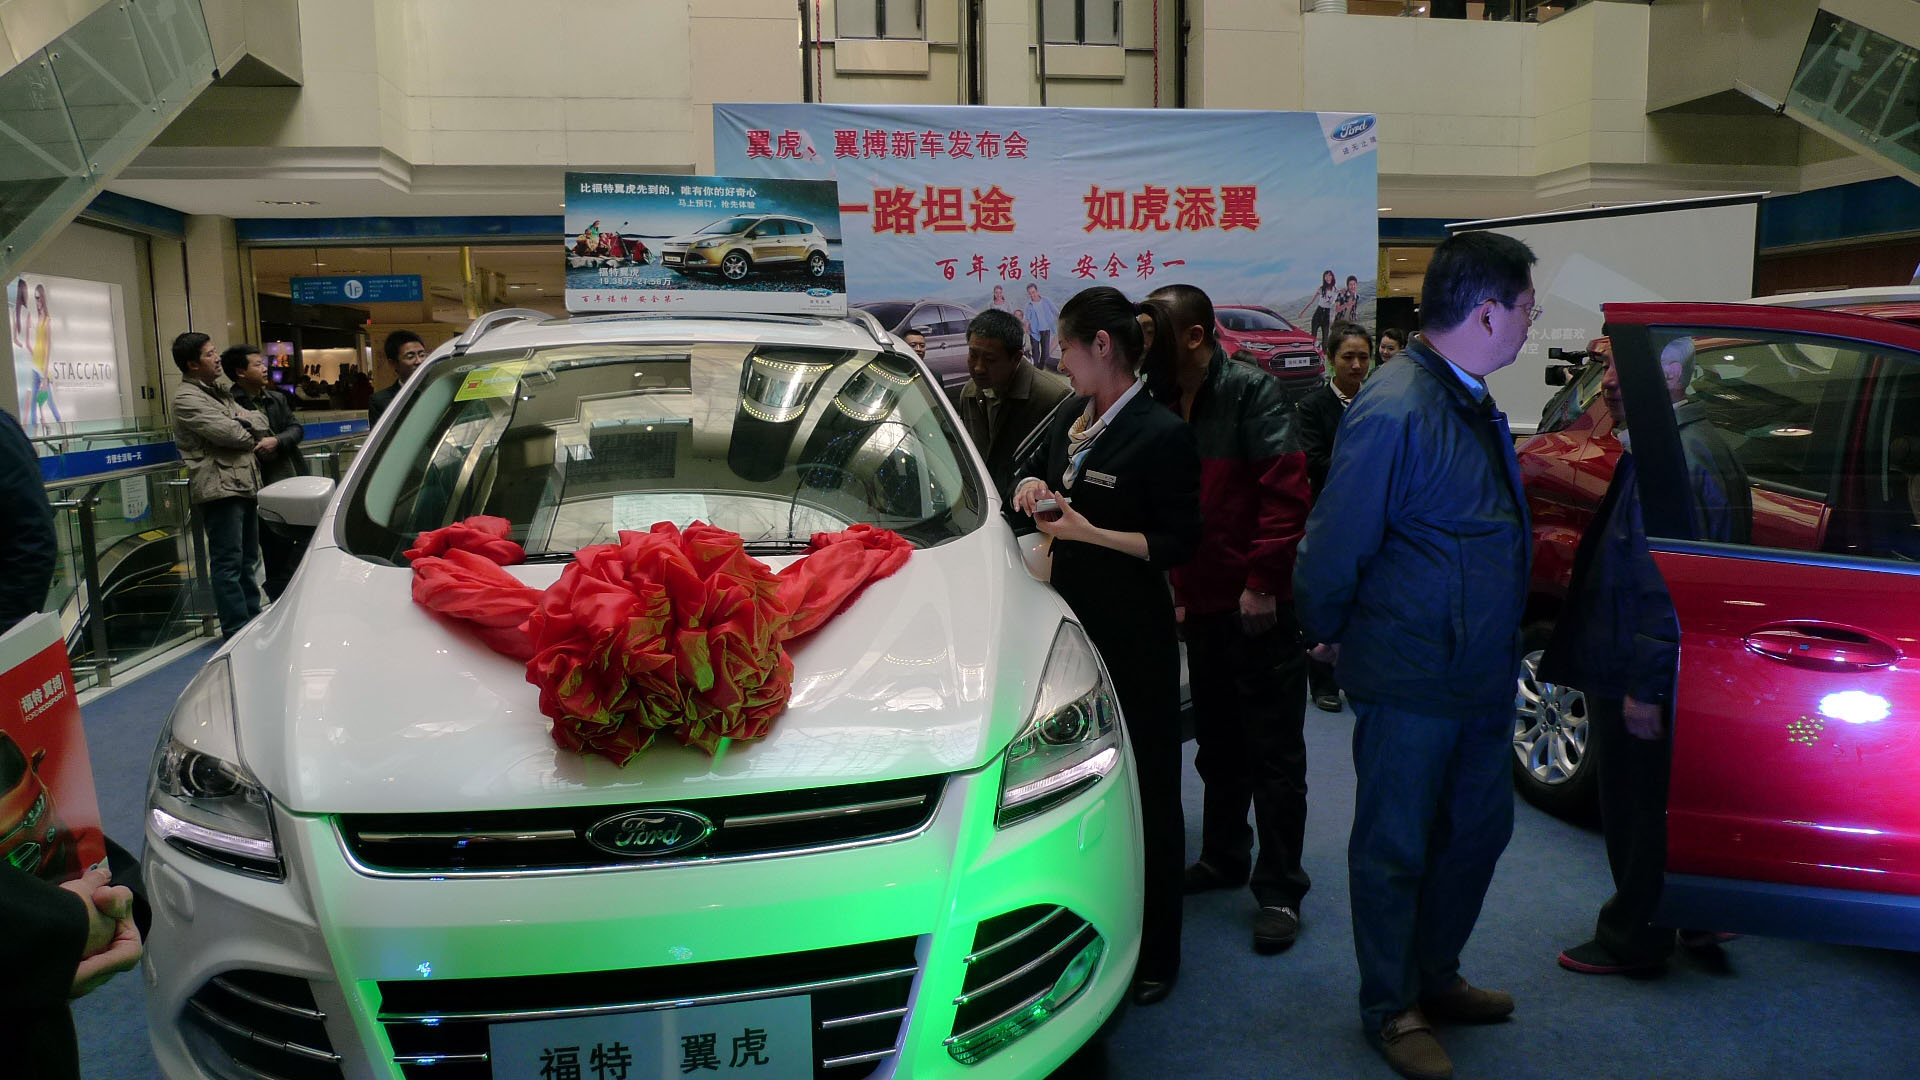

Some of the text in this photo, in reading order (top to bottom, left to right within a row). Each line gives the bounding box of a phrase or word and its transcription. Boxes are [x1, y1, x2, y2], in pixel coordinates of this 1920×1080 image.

[1339, 119, 1369, 138] Ford
[746, 129, 1030, 160] 翼虎、翼搏新车发布会
[840, 184, 1262, 236] 一路坦途 如虎添翼
[935, 249, 1186, 284] 百年福特 安全第一
[348, 282, 361, 297] 1F
[53, 361, 112, 380] STACCATO
[614, 816, 683, 847] Ford
[539, 1027, 770, 1080] 福特 翼虎
